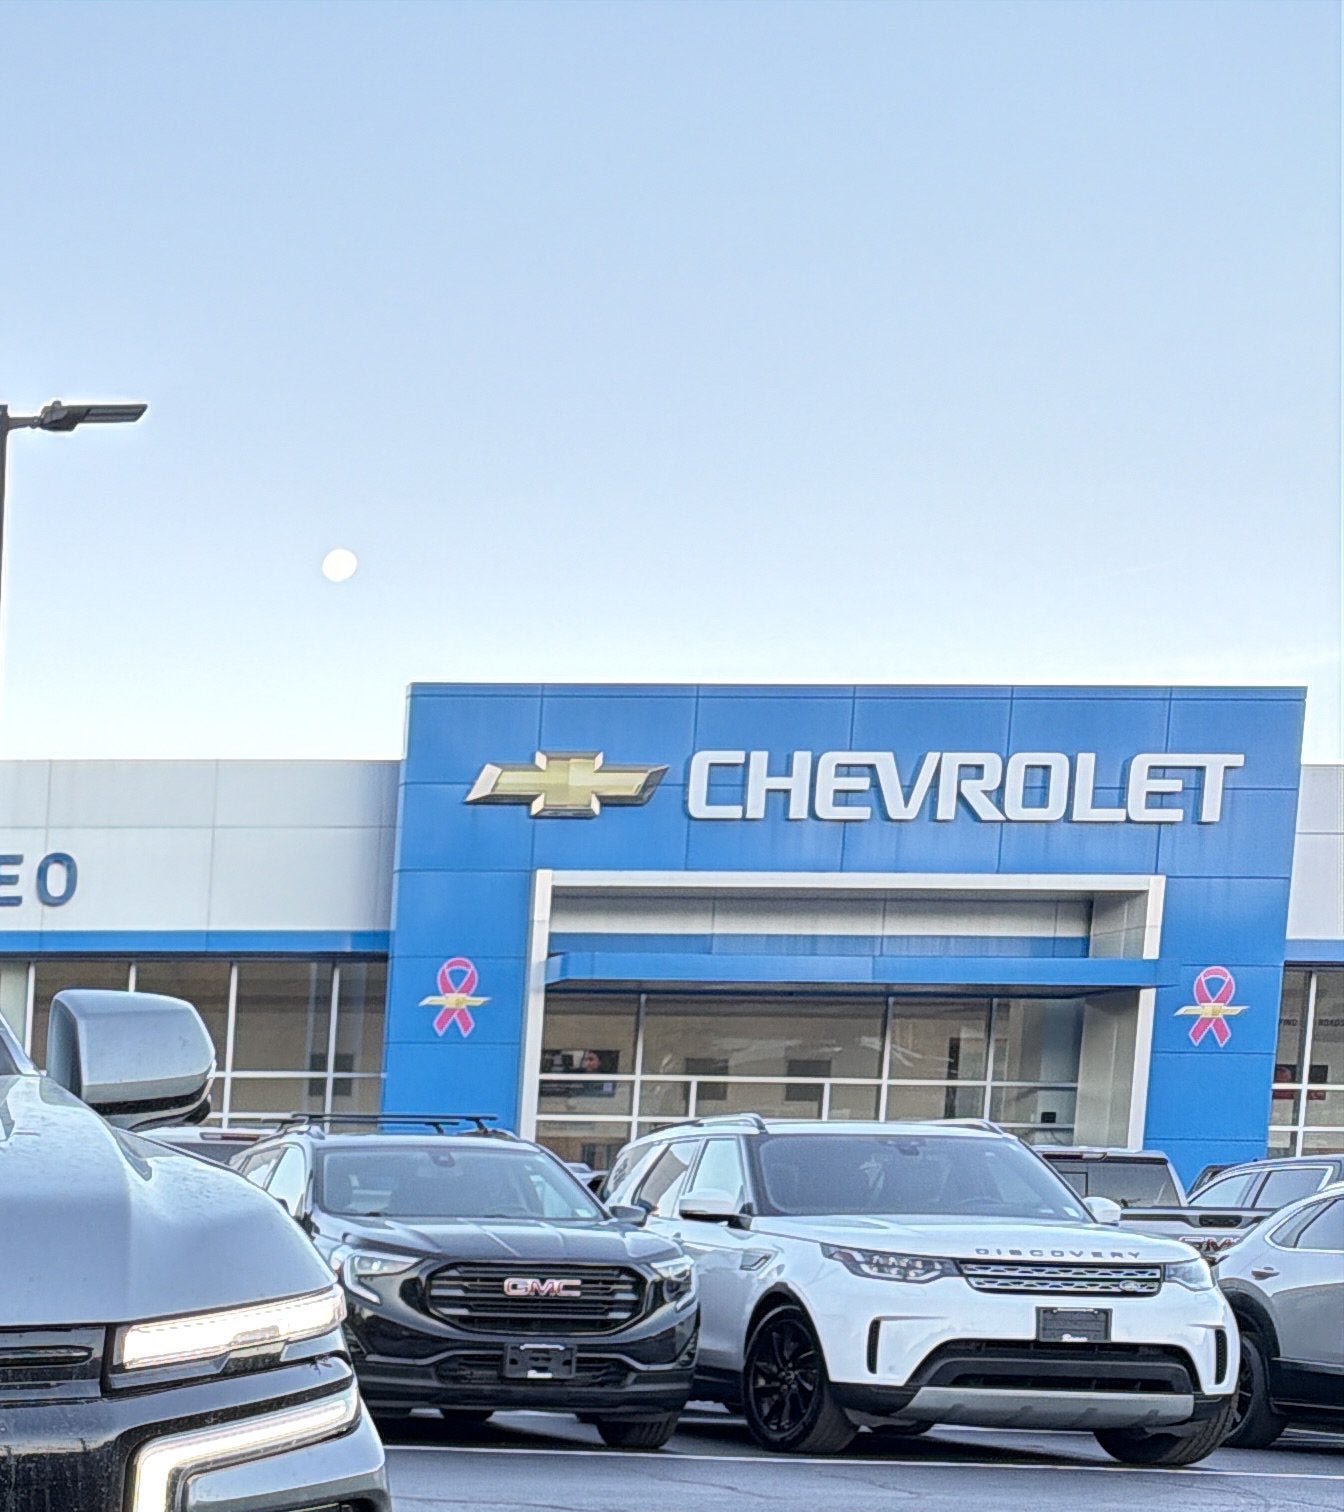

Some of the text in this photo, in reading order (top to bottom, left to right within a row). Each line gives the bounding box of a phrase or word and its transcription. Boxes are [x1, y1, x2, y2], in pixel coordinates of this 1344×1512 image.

[687, 750, 1245, 822] CHEVROLET
[975, 1247, 1141, 1259] DISCOVERY
[503, 1277, 582, 1297] GMC
